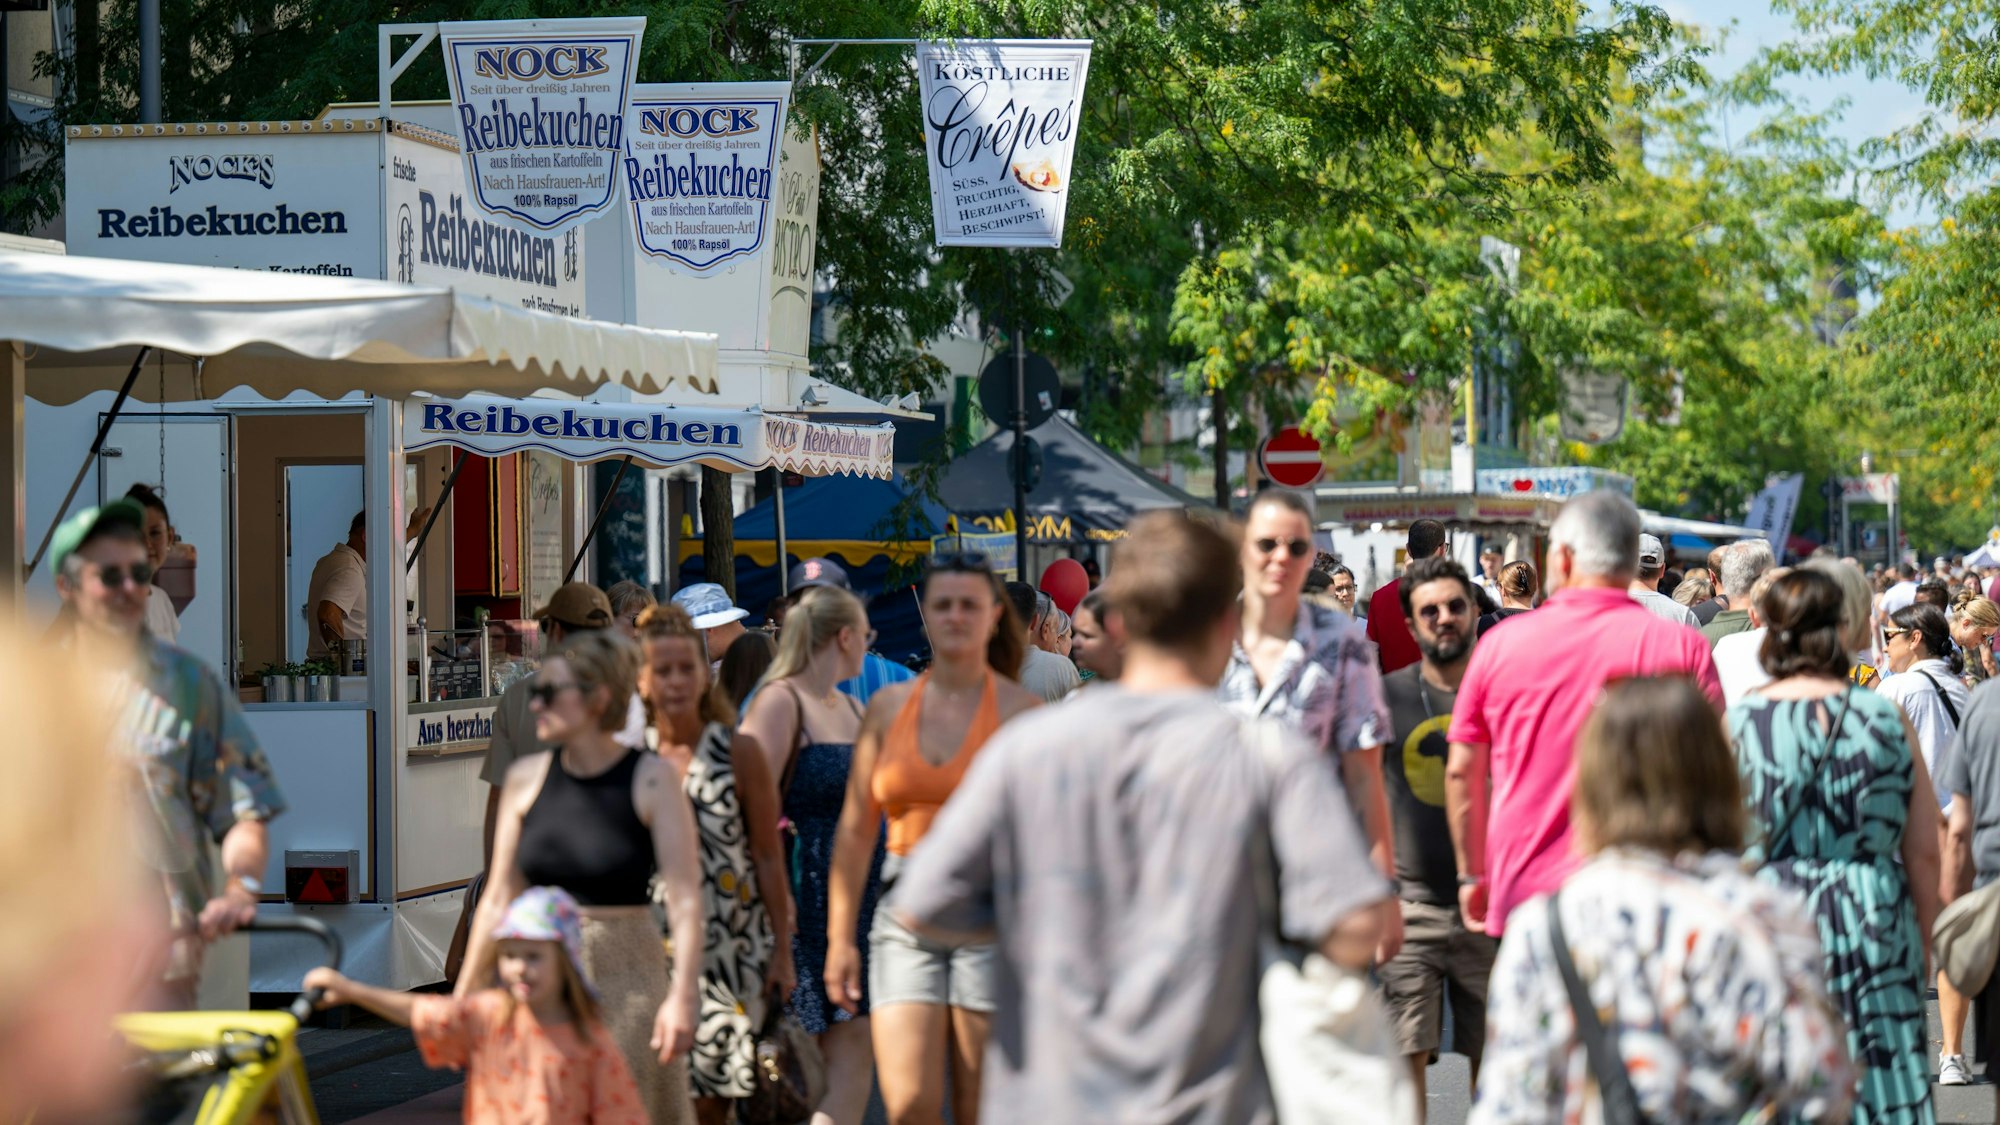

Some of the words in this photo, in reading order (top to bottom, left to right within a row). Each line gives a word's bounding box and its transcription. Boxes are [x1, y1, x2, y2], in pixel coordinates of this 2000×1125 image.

[475, 46, 609, 80] NOCK
[934, 63, 1070, 81] KÖSTLICHE
[470, 84, 492, 95] Seit
[496, 83, 524, 94] über
[526, 83, 567, 96] dreißig
[570, 83, 610, 93] Jahren
[458, 97, 623, 153] Reibekuchen
[640, 106, 760, 139] NOCK
[927, 81, 1074, 181] Crêpes
[490, 156, 508, 168] aus
[510, 153, 550, 168] frischen
[553, 151, 603, 168] Kartoffeln
[635, 141, 654, 151] Seit
[657, 140, 682, 150] über
[685, 140, 722, 151] dreißig
[724, 140, 760, 149] Jahren
[393, 155, 416, 183] frische
[484, 174, 514, 190] Nach
[517, 173, 606, 189] Hausfrauen-Art!
[624, 152, 772, 201] Reibekuchen
[952, 177, 988, 192] SÜSS,
[956, 185, 1020, 206] FRUCHTIG,
[513, 195, 541, 208] 100%
[544, 194, 578, 209] Rapsöl
[651, 205, 667, 216] aus
[669, 203, 706, 216] frischen
[708, 202, 753, 216] Kartoffeln
[959, 198, 1030, 221] HERZHAFT,
[97, 204, 348, 238] Reibekuchen
[645, 221, 672, 235] Nach
[675, 221, 756, 235] Hausfrauen-Art!
[961, 208, 1046, 236] BESCHWIPST!
[419, 189, 557, 288] Reibekuchen
[672, 239, 697, 250] 100%
[699, 239, 730, 252] Rapsöl
[773, 218, 811, 281] BISTRO
[421, 404, 741, 446] Reibekuchen
[765, 420, 799, 454] NOCK
[802, 424, 872, 458] Reibekuchen
[417, 718, 443, 746] Aus
[446, 712, 493, 742] herzha
